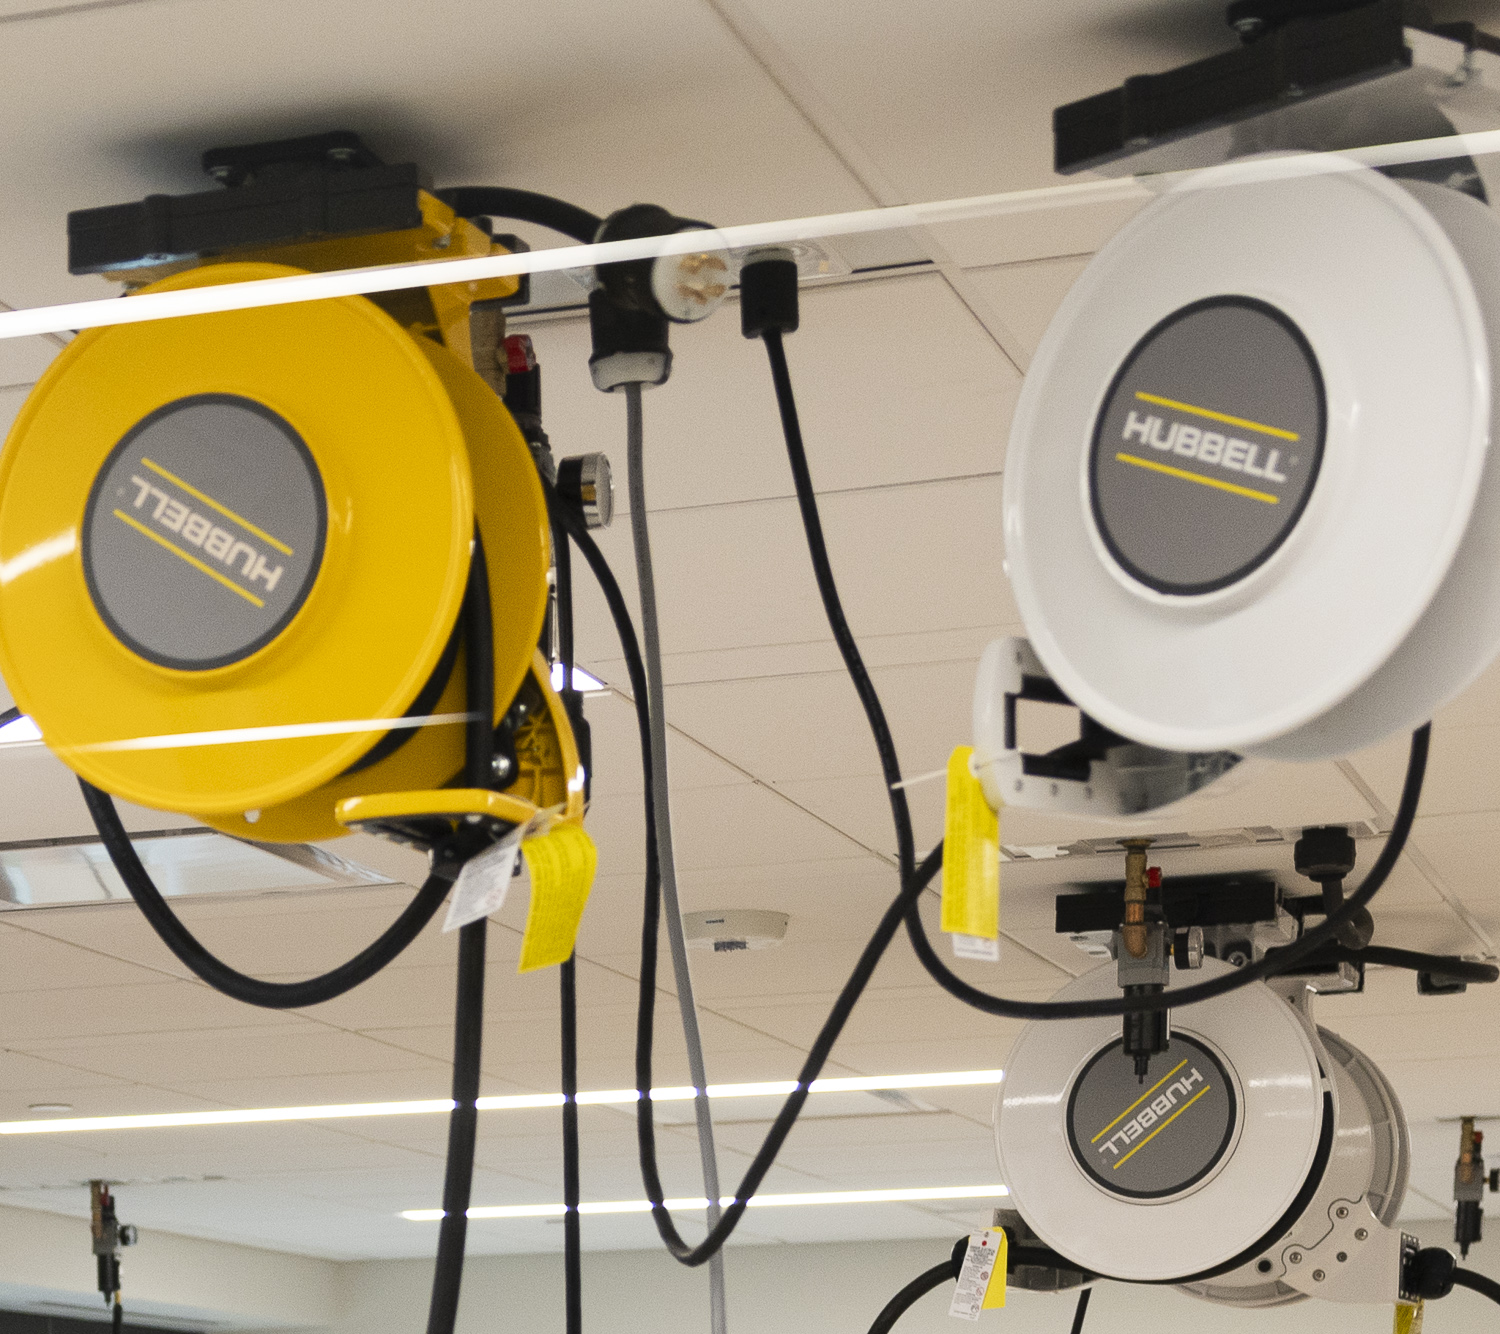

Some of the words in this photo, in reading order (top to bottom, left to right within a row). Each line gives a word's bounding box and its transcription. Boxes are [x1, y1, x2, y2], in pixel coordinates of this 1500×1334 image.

[1123, 409, 1288, 483] HUBBELL
[131, 474, 282, 593] HUBBELL
[1098, 1067, 1204, 1156] HUBBELL
